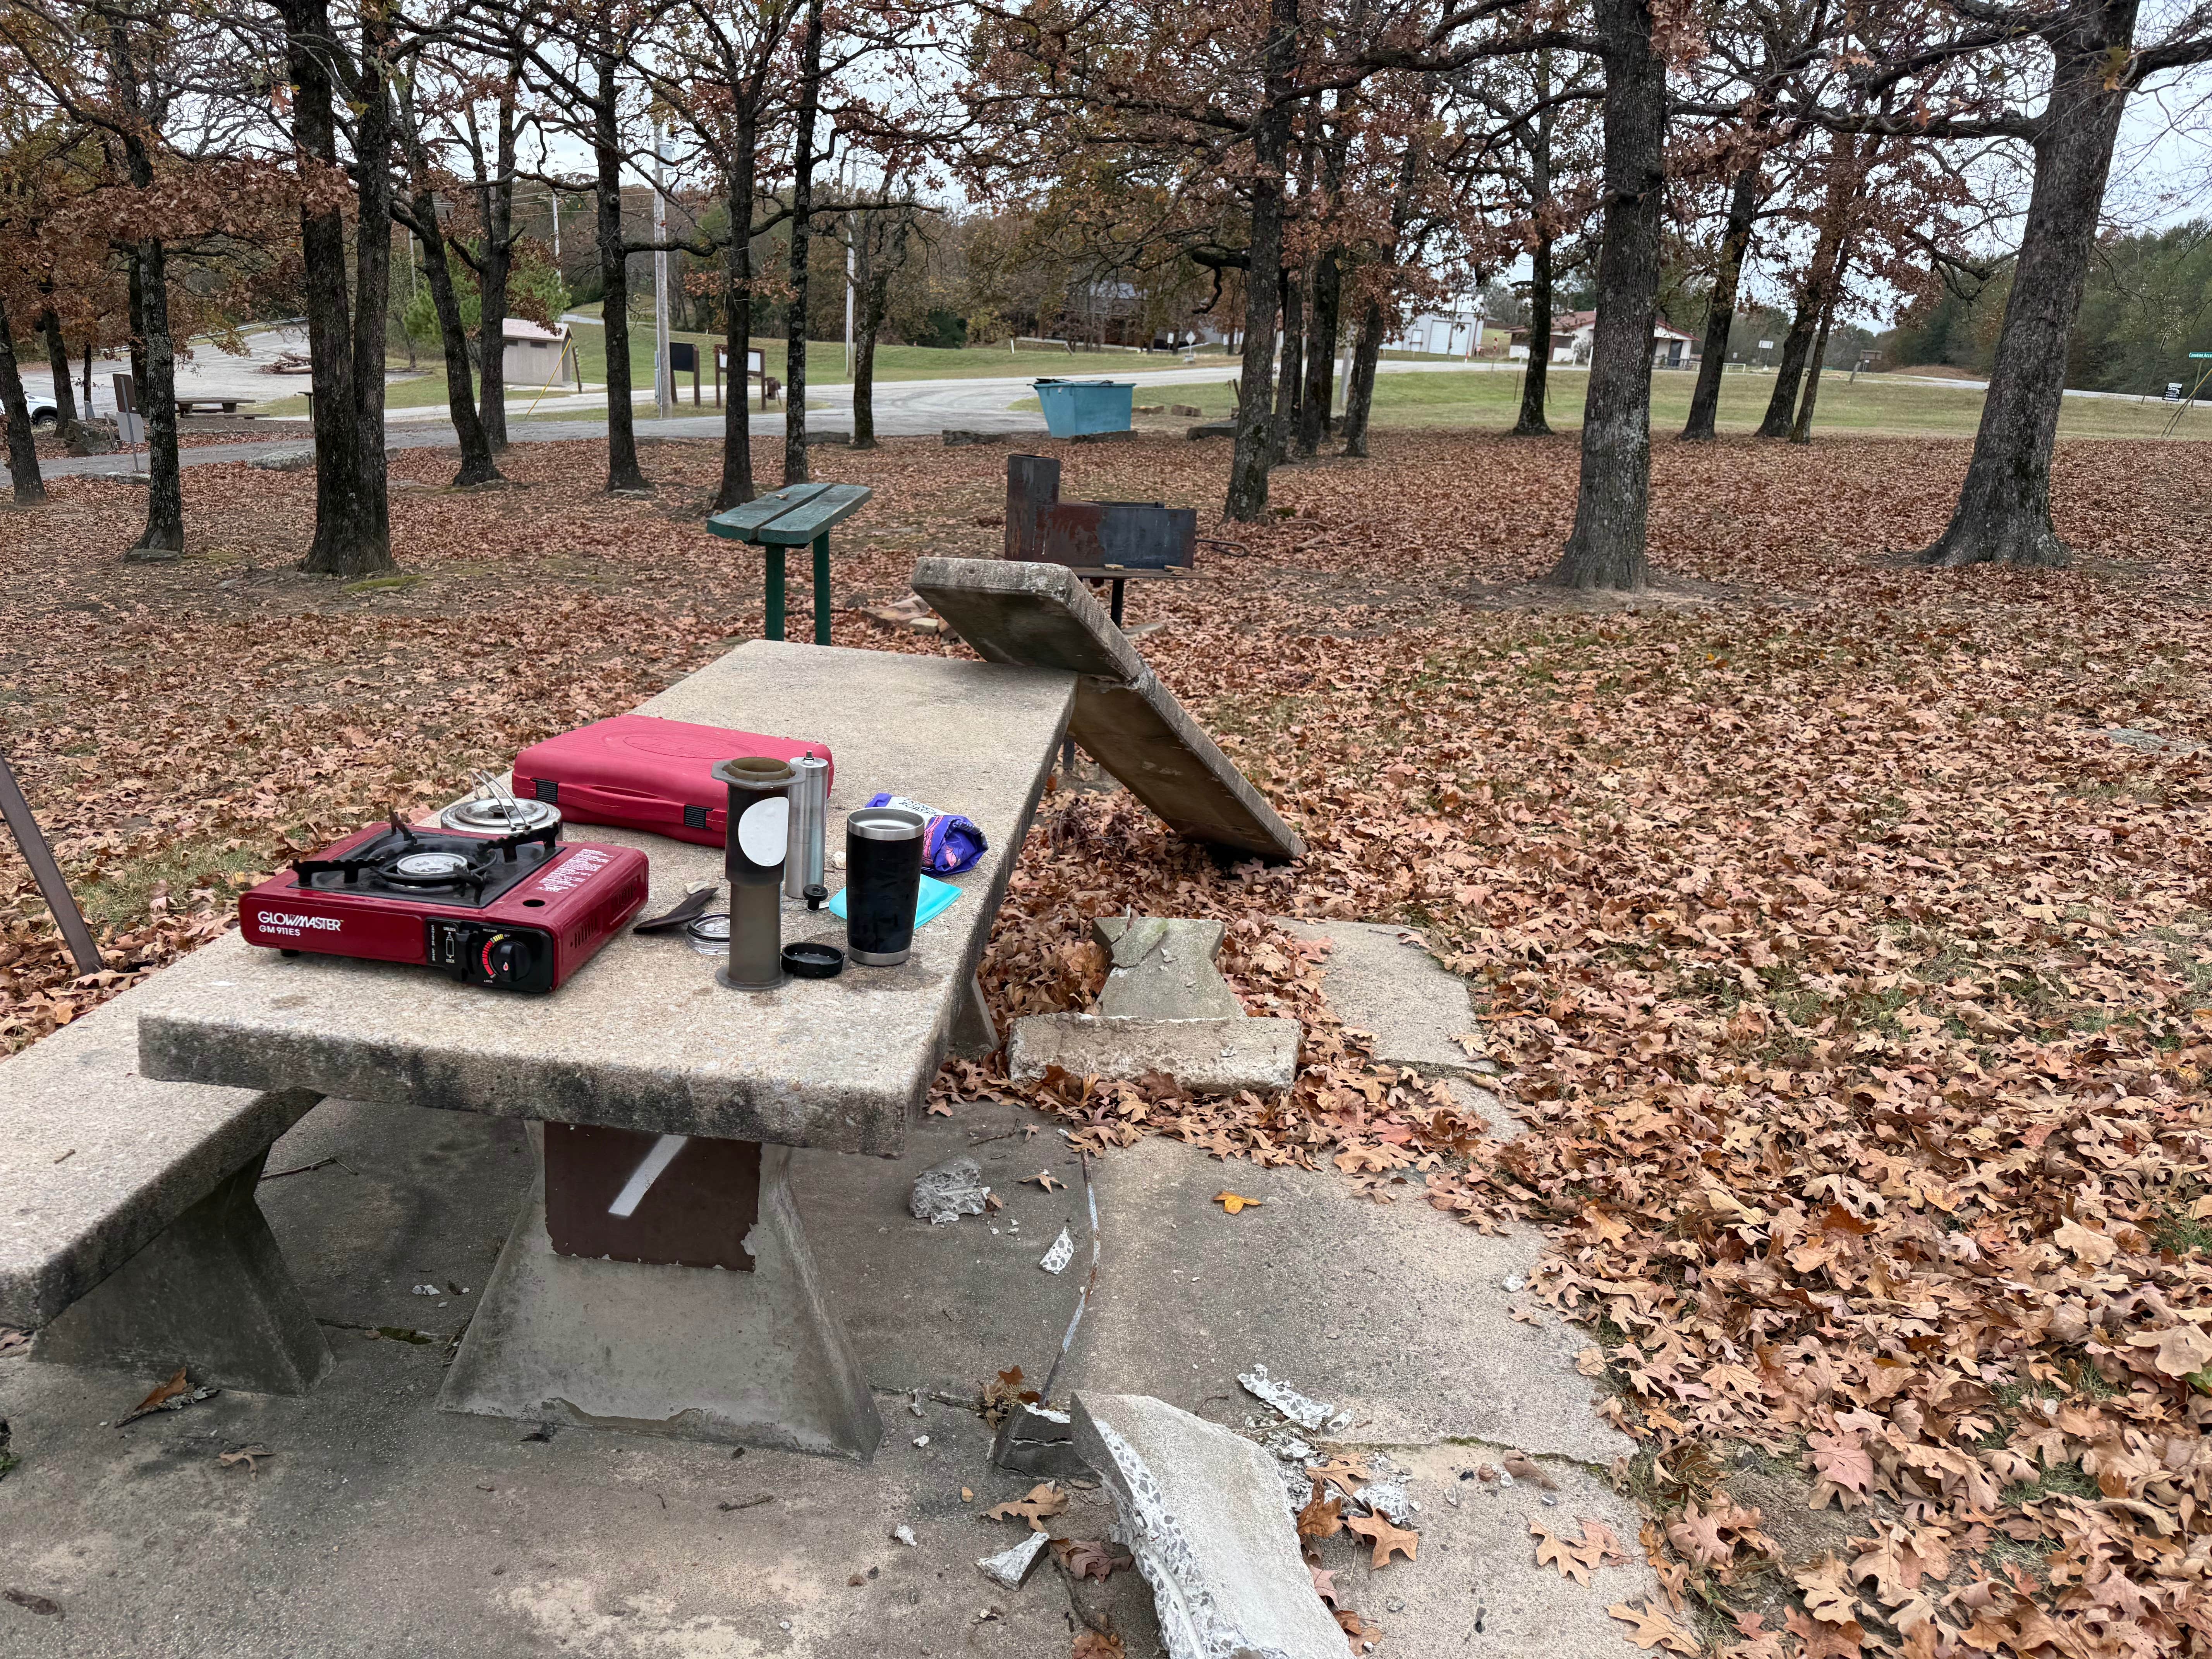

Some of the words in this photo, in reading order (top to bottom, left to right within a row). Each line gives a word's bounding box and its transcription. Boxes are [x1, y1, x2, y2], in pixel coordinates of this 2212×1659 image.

[898, 802, 931, 815] ROAST
[258, 911, 341, 931] GLOWMASTER
[259, 925, 275, 933] GM
[276, 927, 301, 936] 911ES
